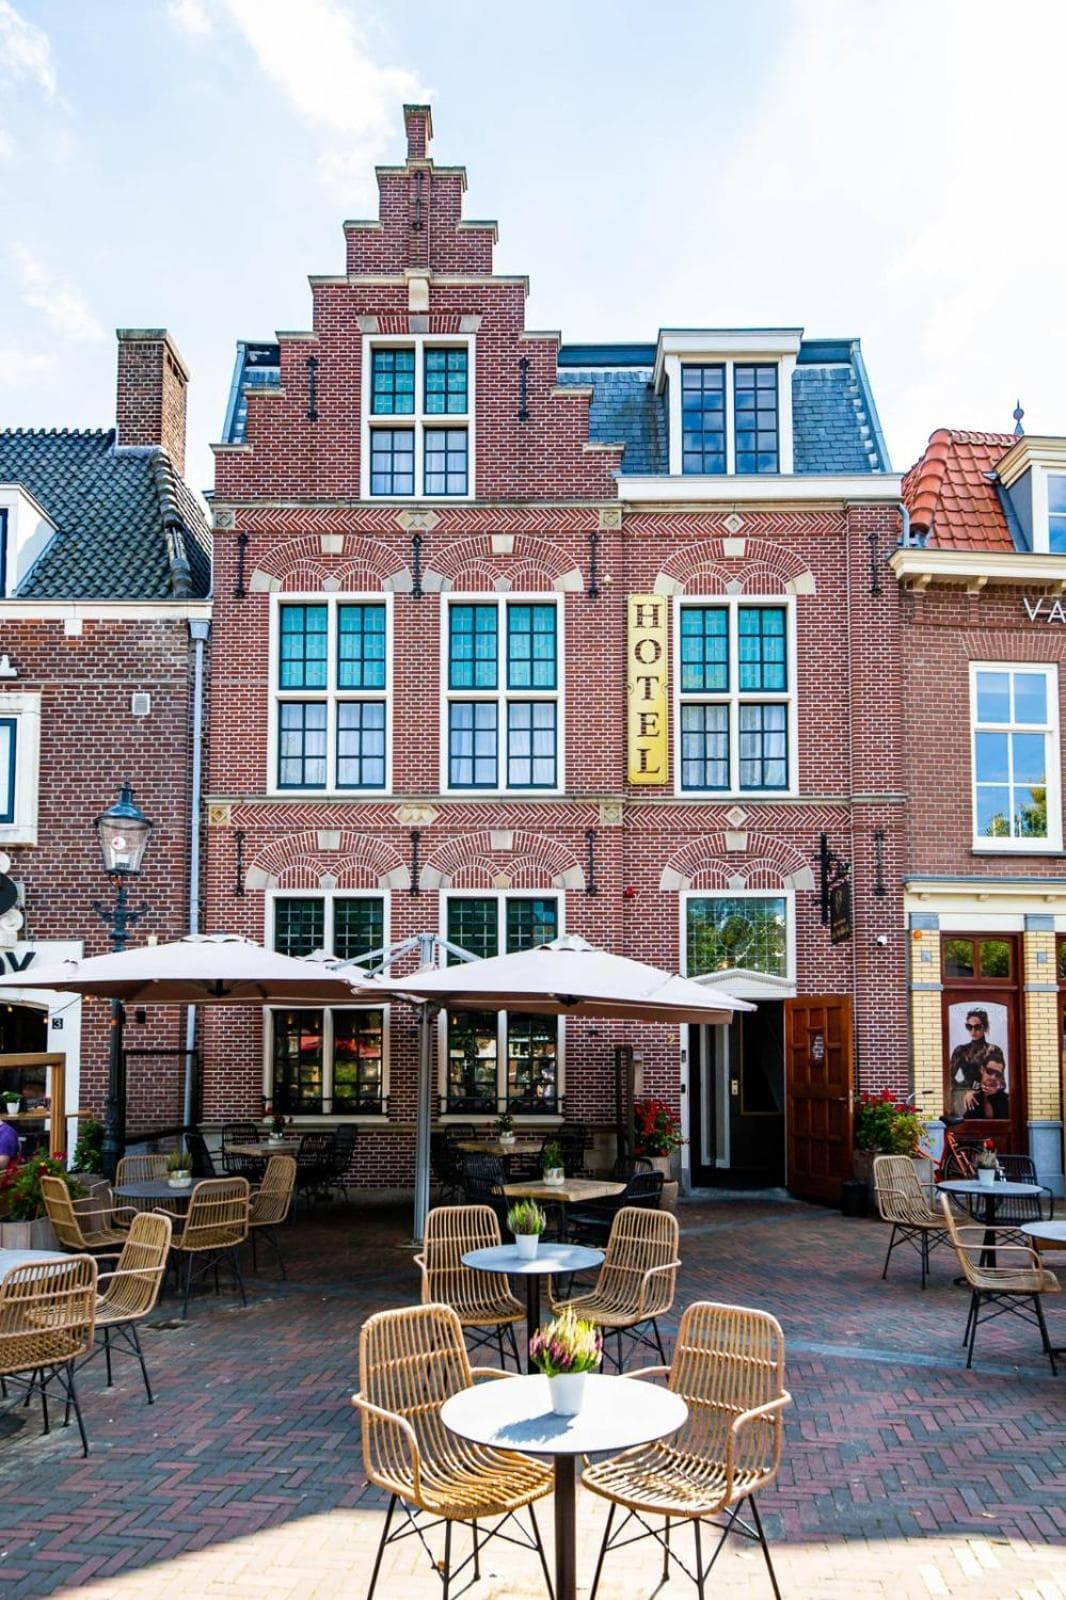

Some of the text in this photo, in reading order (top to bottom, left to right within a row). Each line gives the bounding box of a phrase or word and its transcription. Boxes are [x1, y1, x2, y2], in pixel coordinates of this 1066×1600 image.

[633, 603, 662, 774] HOTEL
[0, 952, 36, 976] V
[54, 1018, 62, 1029] 3
